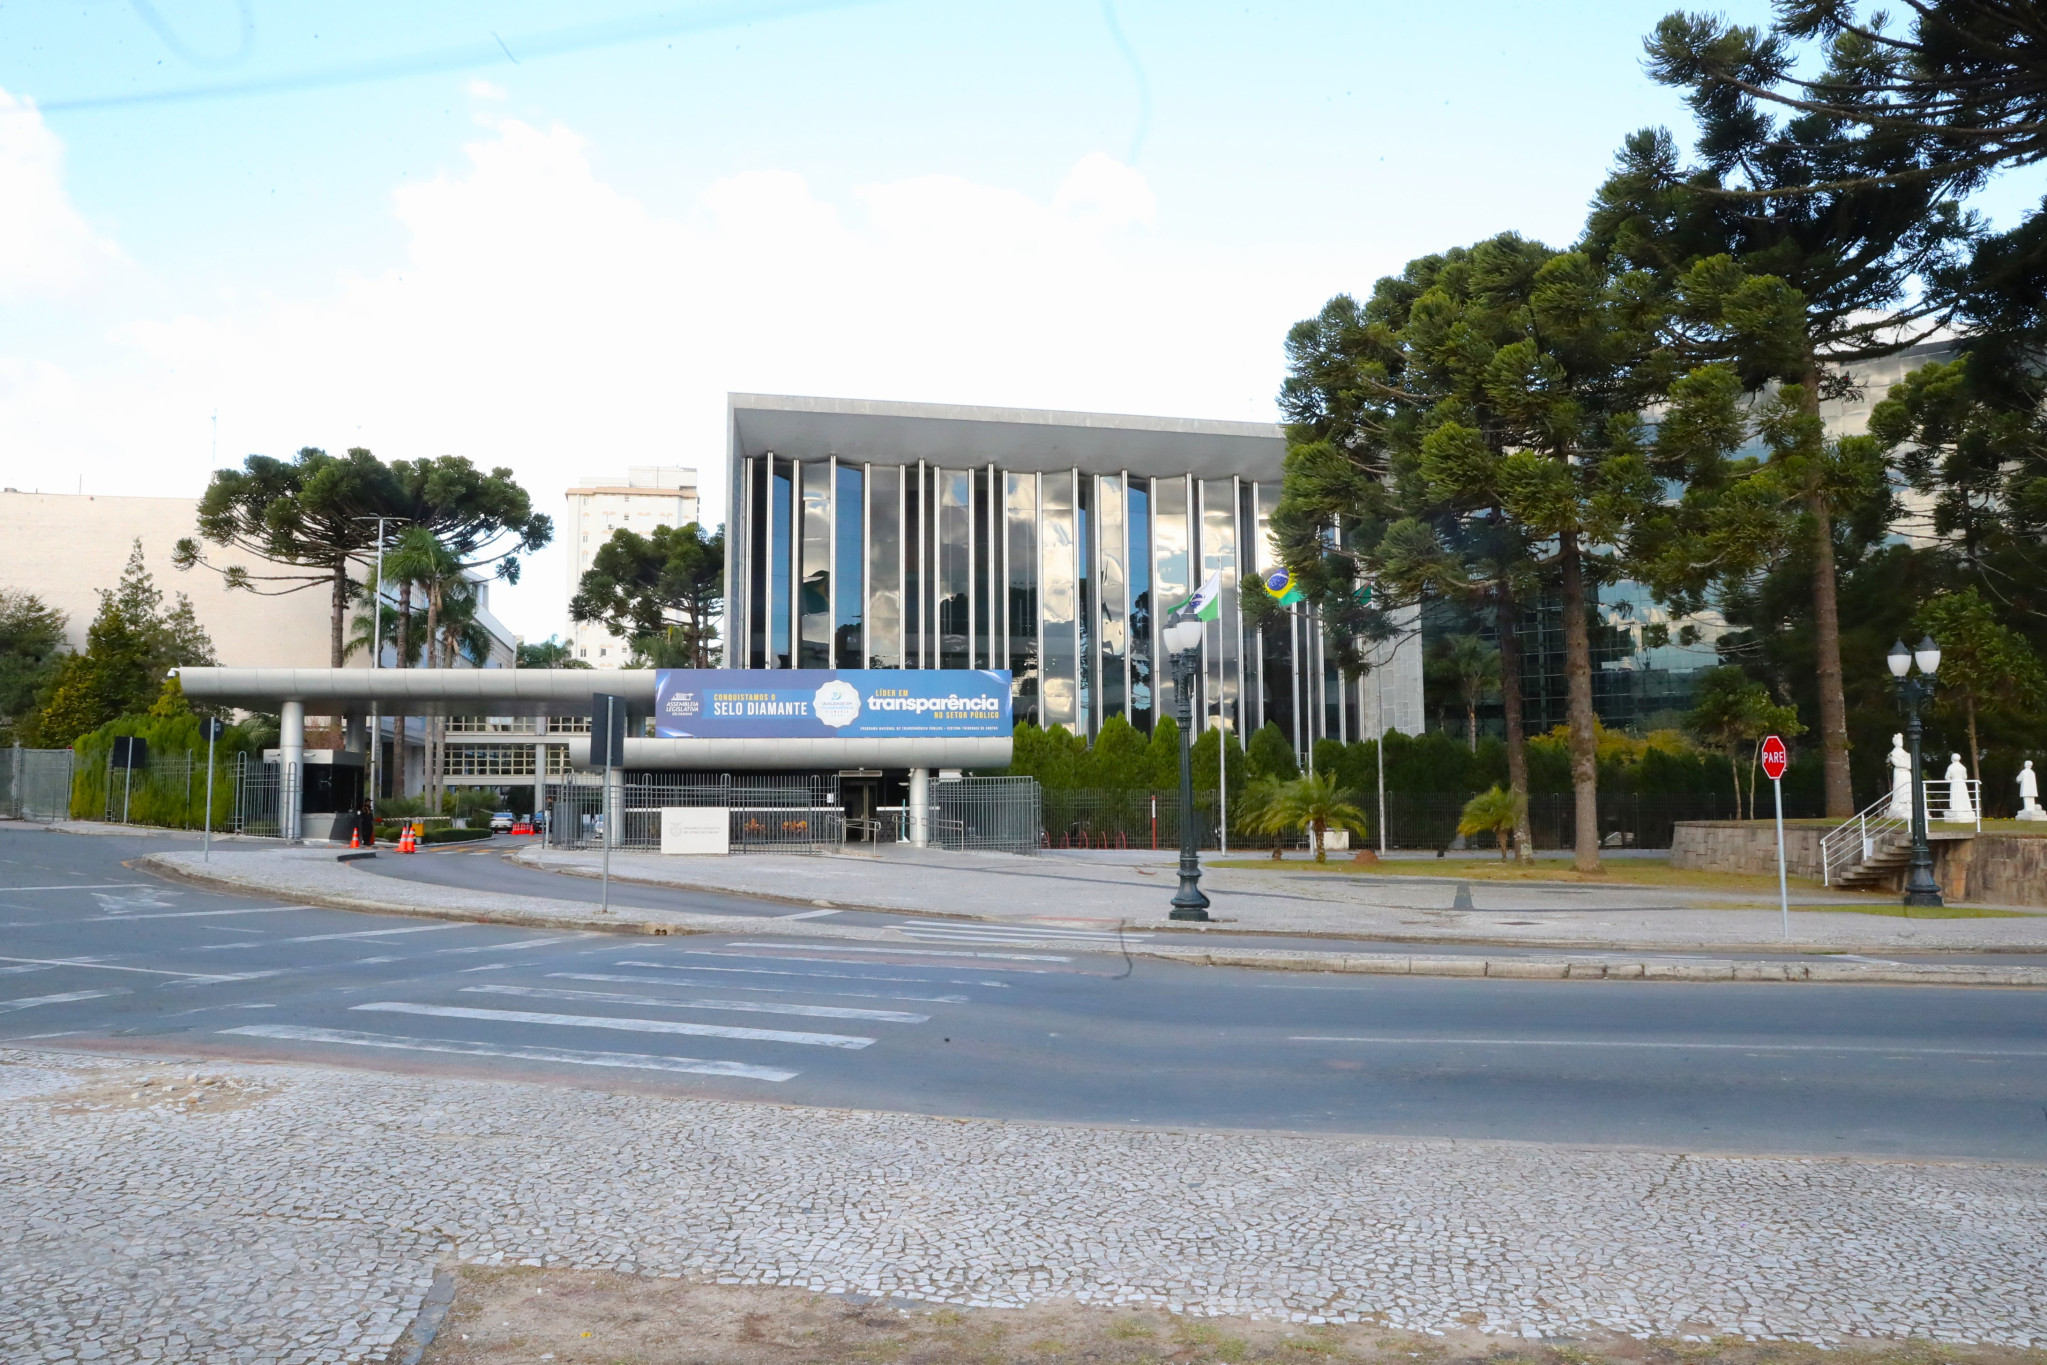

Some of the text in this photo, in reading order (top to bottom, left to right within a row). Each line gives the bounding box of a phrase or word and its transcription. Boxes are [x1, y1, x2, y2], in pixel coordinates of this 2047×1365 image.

[713, 693, 776, 701] CONQUISTAMOS O
[875, 688, 909, 697] LÍDER EM
[713, 702, 808, 715] SELO DIAMANTE
[867, 693, 999, 714] transparência
[934, 710, 999, 719] NO SETOR PÚBLICO
[1763, 751, 1785, 763] PARE
